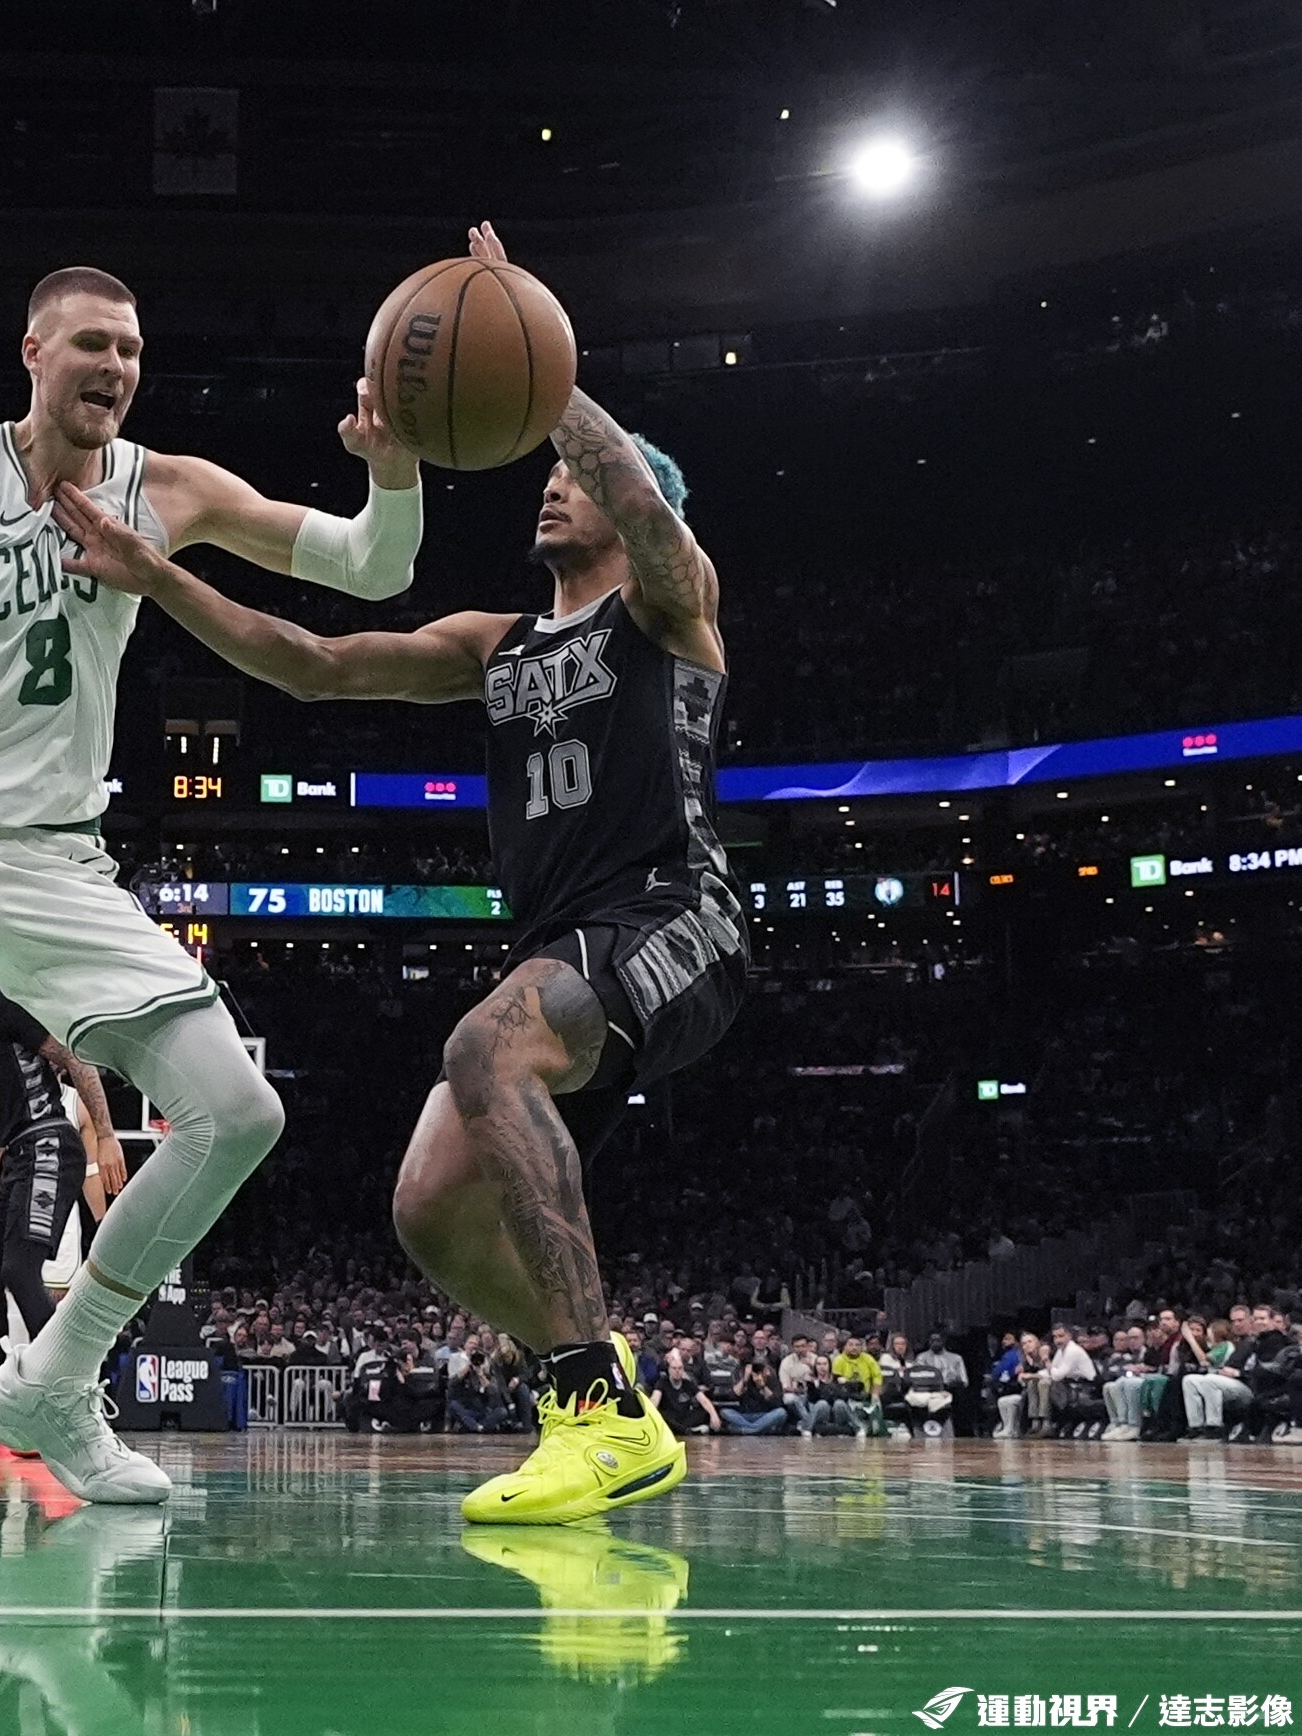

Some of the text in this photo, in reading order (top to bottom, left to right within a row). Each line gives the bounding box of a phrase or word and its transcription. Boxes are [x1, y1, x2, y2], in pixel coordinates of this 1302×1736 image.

[18, 613, 73, 706] 8
[485, 629, 618, 728] SATX
[105, 778, 123, 793] nk
[173, 775, 222, 798] 8:34
[262, 777, 337, 799] TD Bank
[526, 738, 593, 820] 10
[1132, 857, 1164, 884] TD
[1169, 857, 1214, 876] Bank
[1229, 851, 1272, 872] 8:34
[248, 888, 384, 914] 75 BOSTON
[754, 891, 845, 909] 3 21 35
[932, 882, 950, 898] 14
[490, 901, 501, 915] 2
[160, 1356, 209, 1384] League
[160, 1378, 195, 1403] Pass
